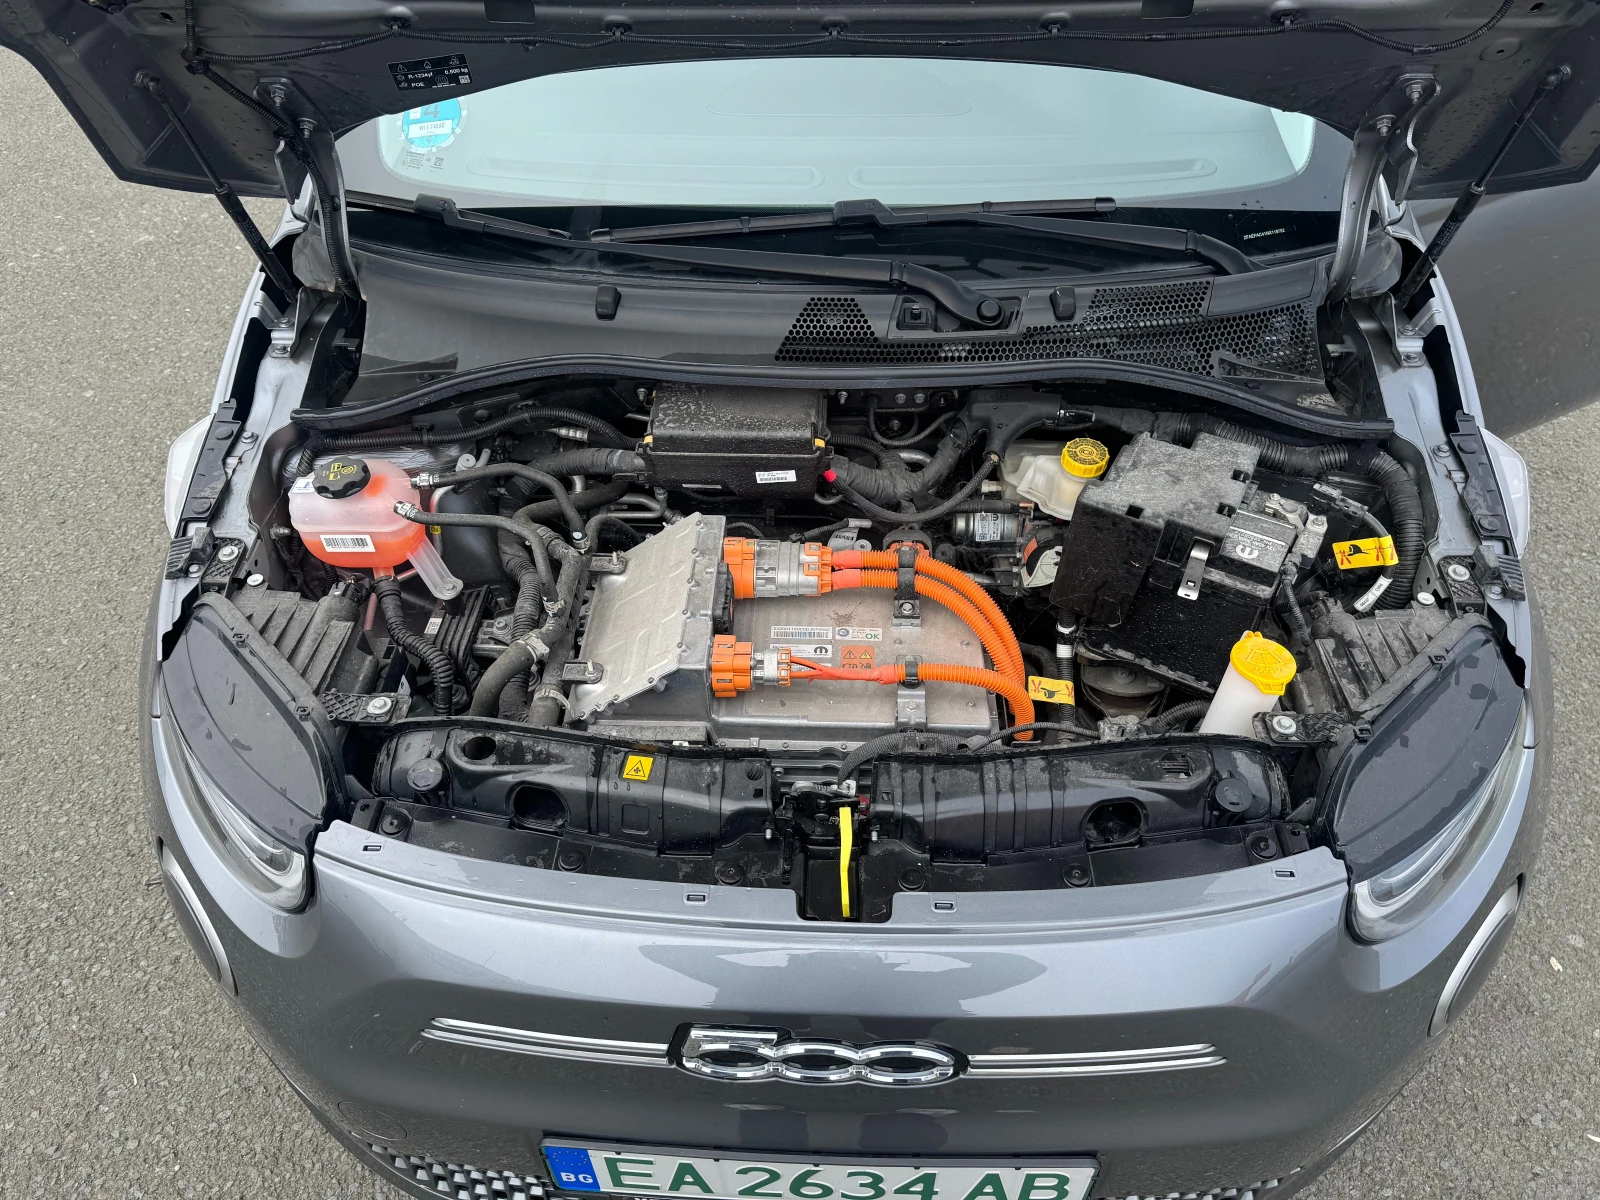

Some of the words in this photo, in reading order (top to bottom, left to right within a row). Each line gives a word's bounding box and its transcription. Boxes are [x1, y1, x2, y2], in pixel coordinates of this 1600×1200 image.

[423, 104, 439, 118] 4
[681, 1028, 954, 1083] 500
[560, 1172, 593, 1183] BG
[604, 1156, 715, 1194] EA
[735, 1166, 940, 1200] 2634
[963, 1173, 1071, 1200] AB
